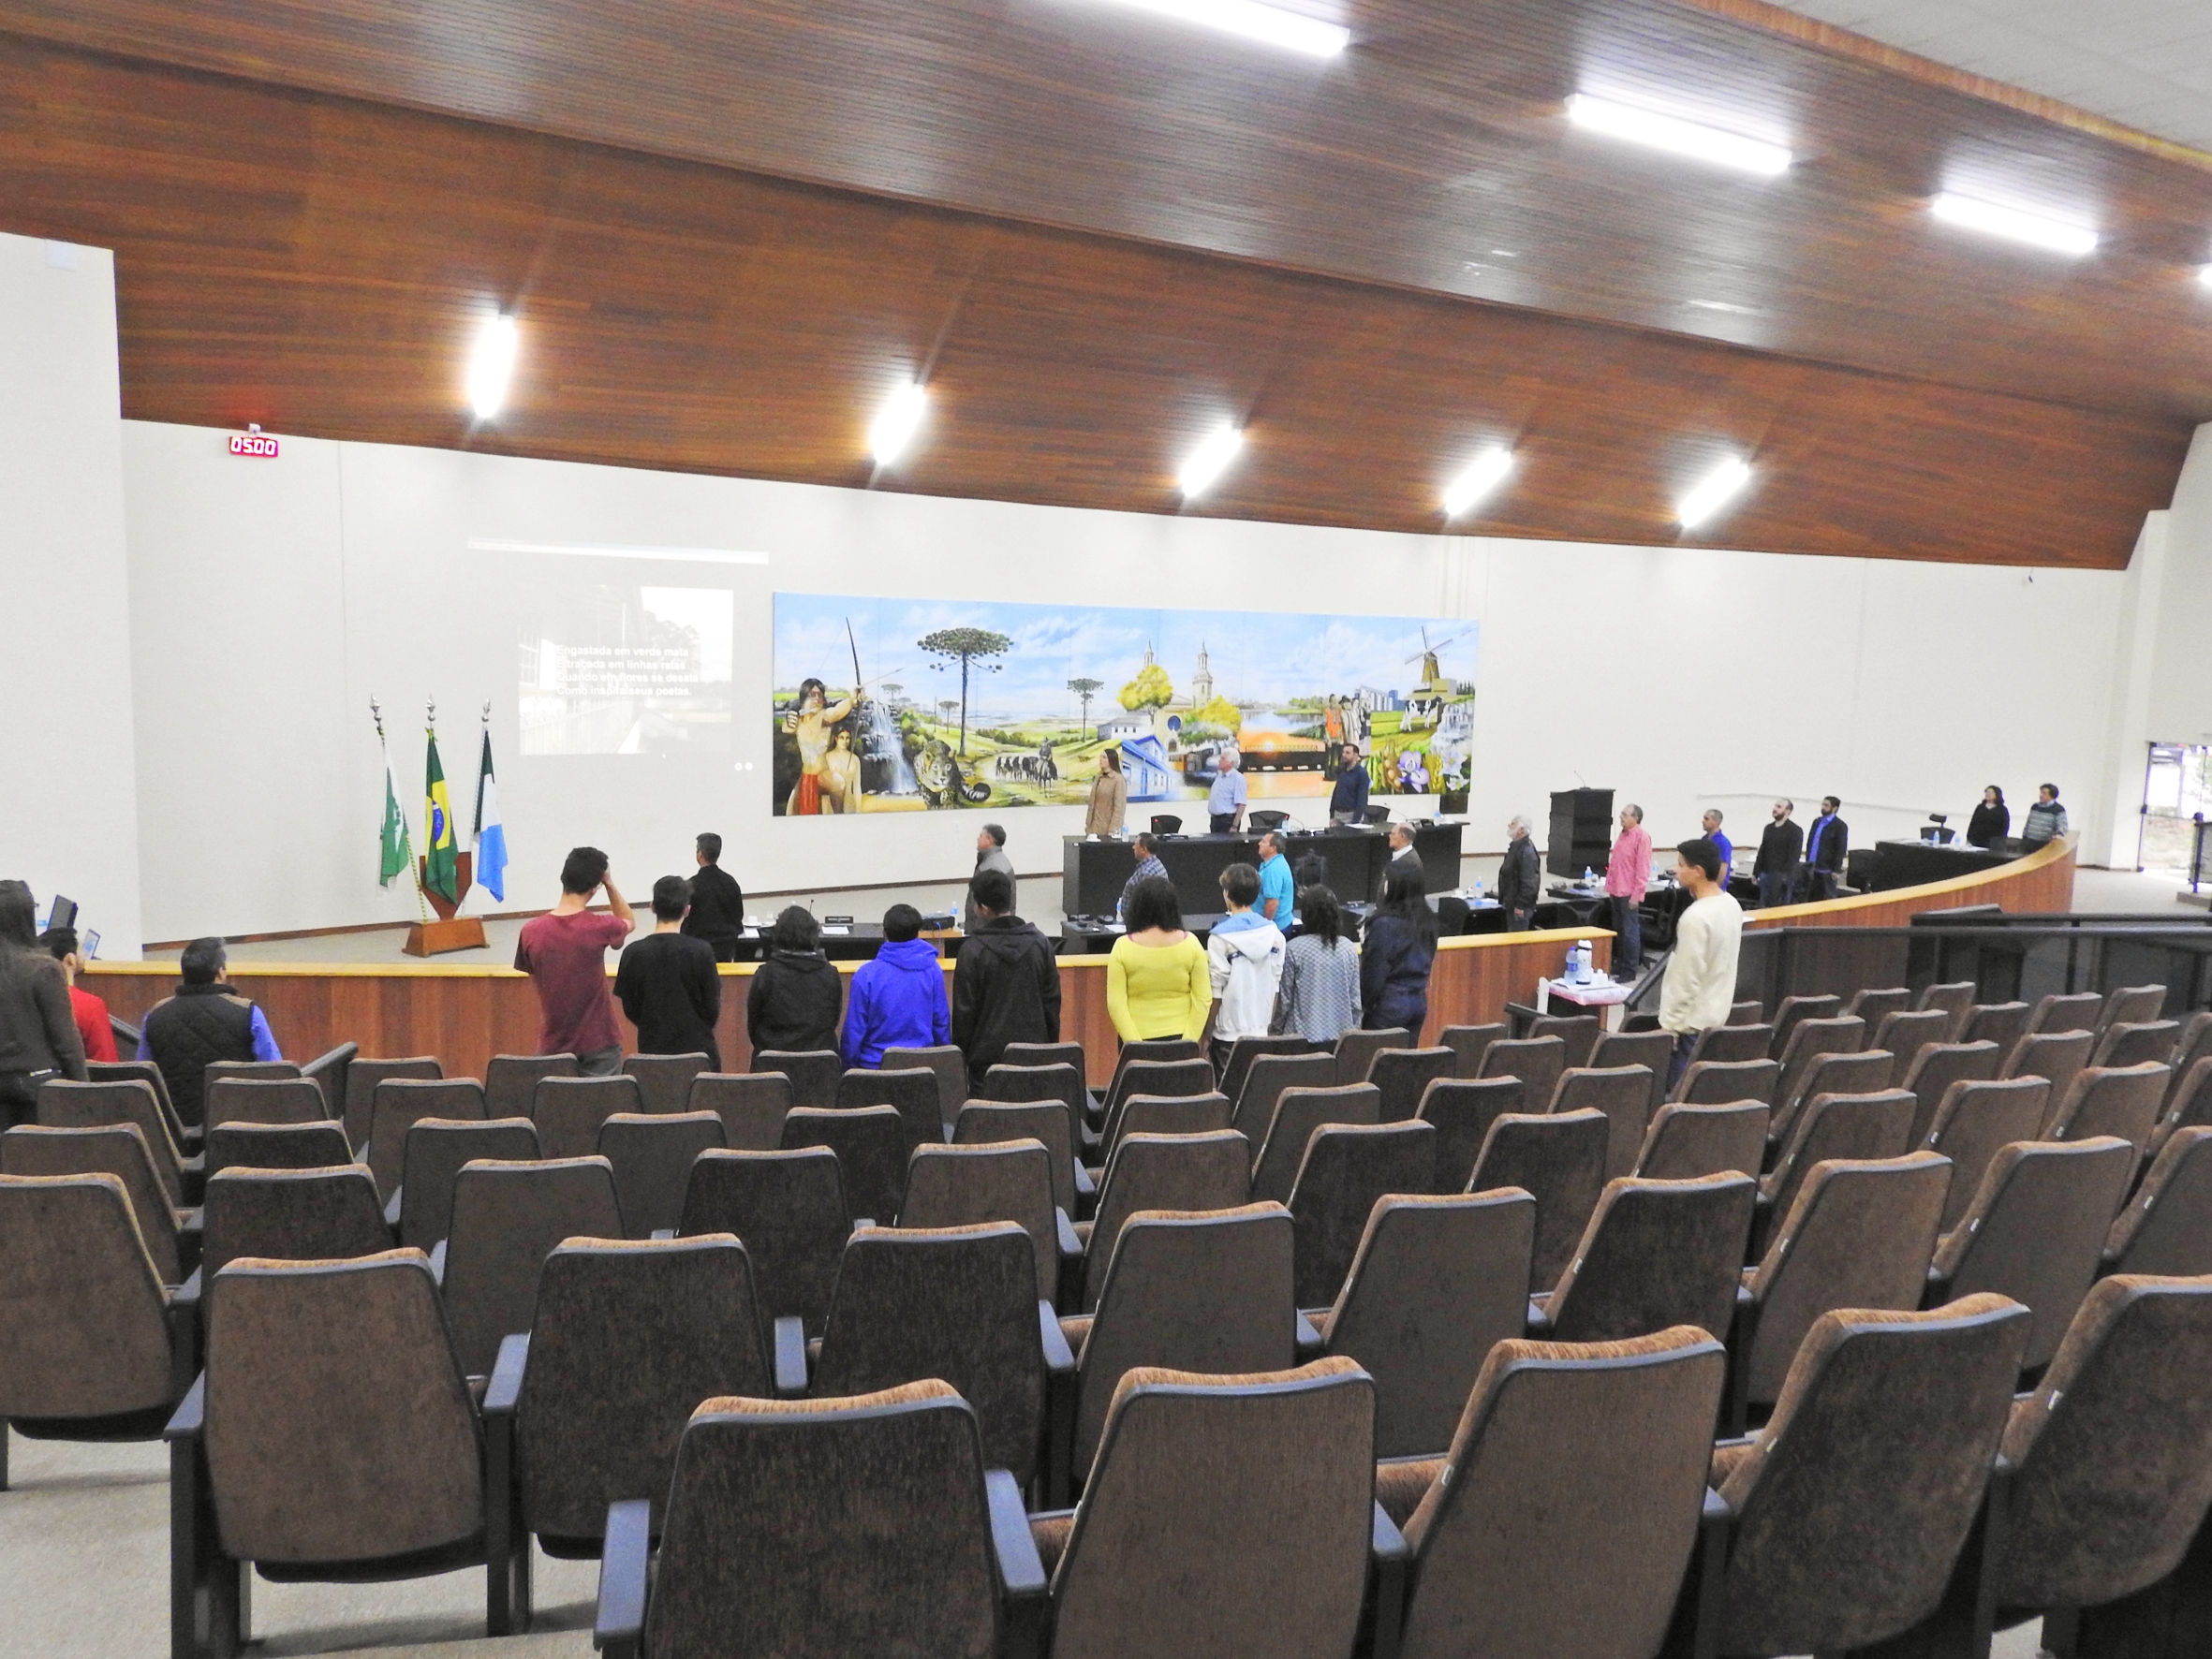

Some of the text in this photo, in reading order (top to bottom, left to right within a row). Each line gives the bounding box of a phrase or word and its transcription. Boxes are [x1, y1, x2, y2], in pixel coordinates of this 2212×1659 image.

[556, 645, 688, 657] Engastada em verde mata
[567, 659, 606, 670] traçada
[608, 661, 625, 669] em
[627, 659, 658, 670] linhas
[660, 660, 686, 670] retas
[556, 672, 699, 683] Quando em flores se desata
[556, 685, 692, 697] Como inspira seus poetas.
